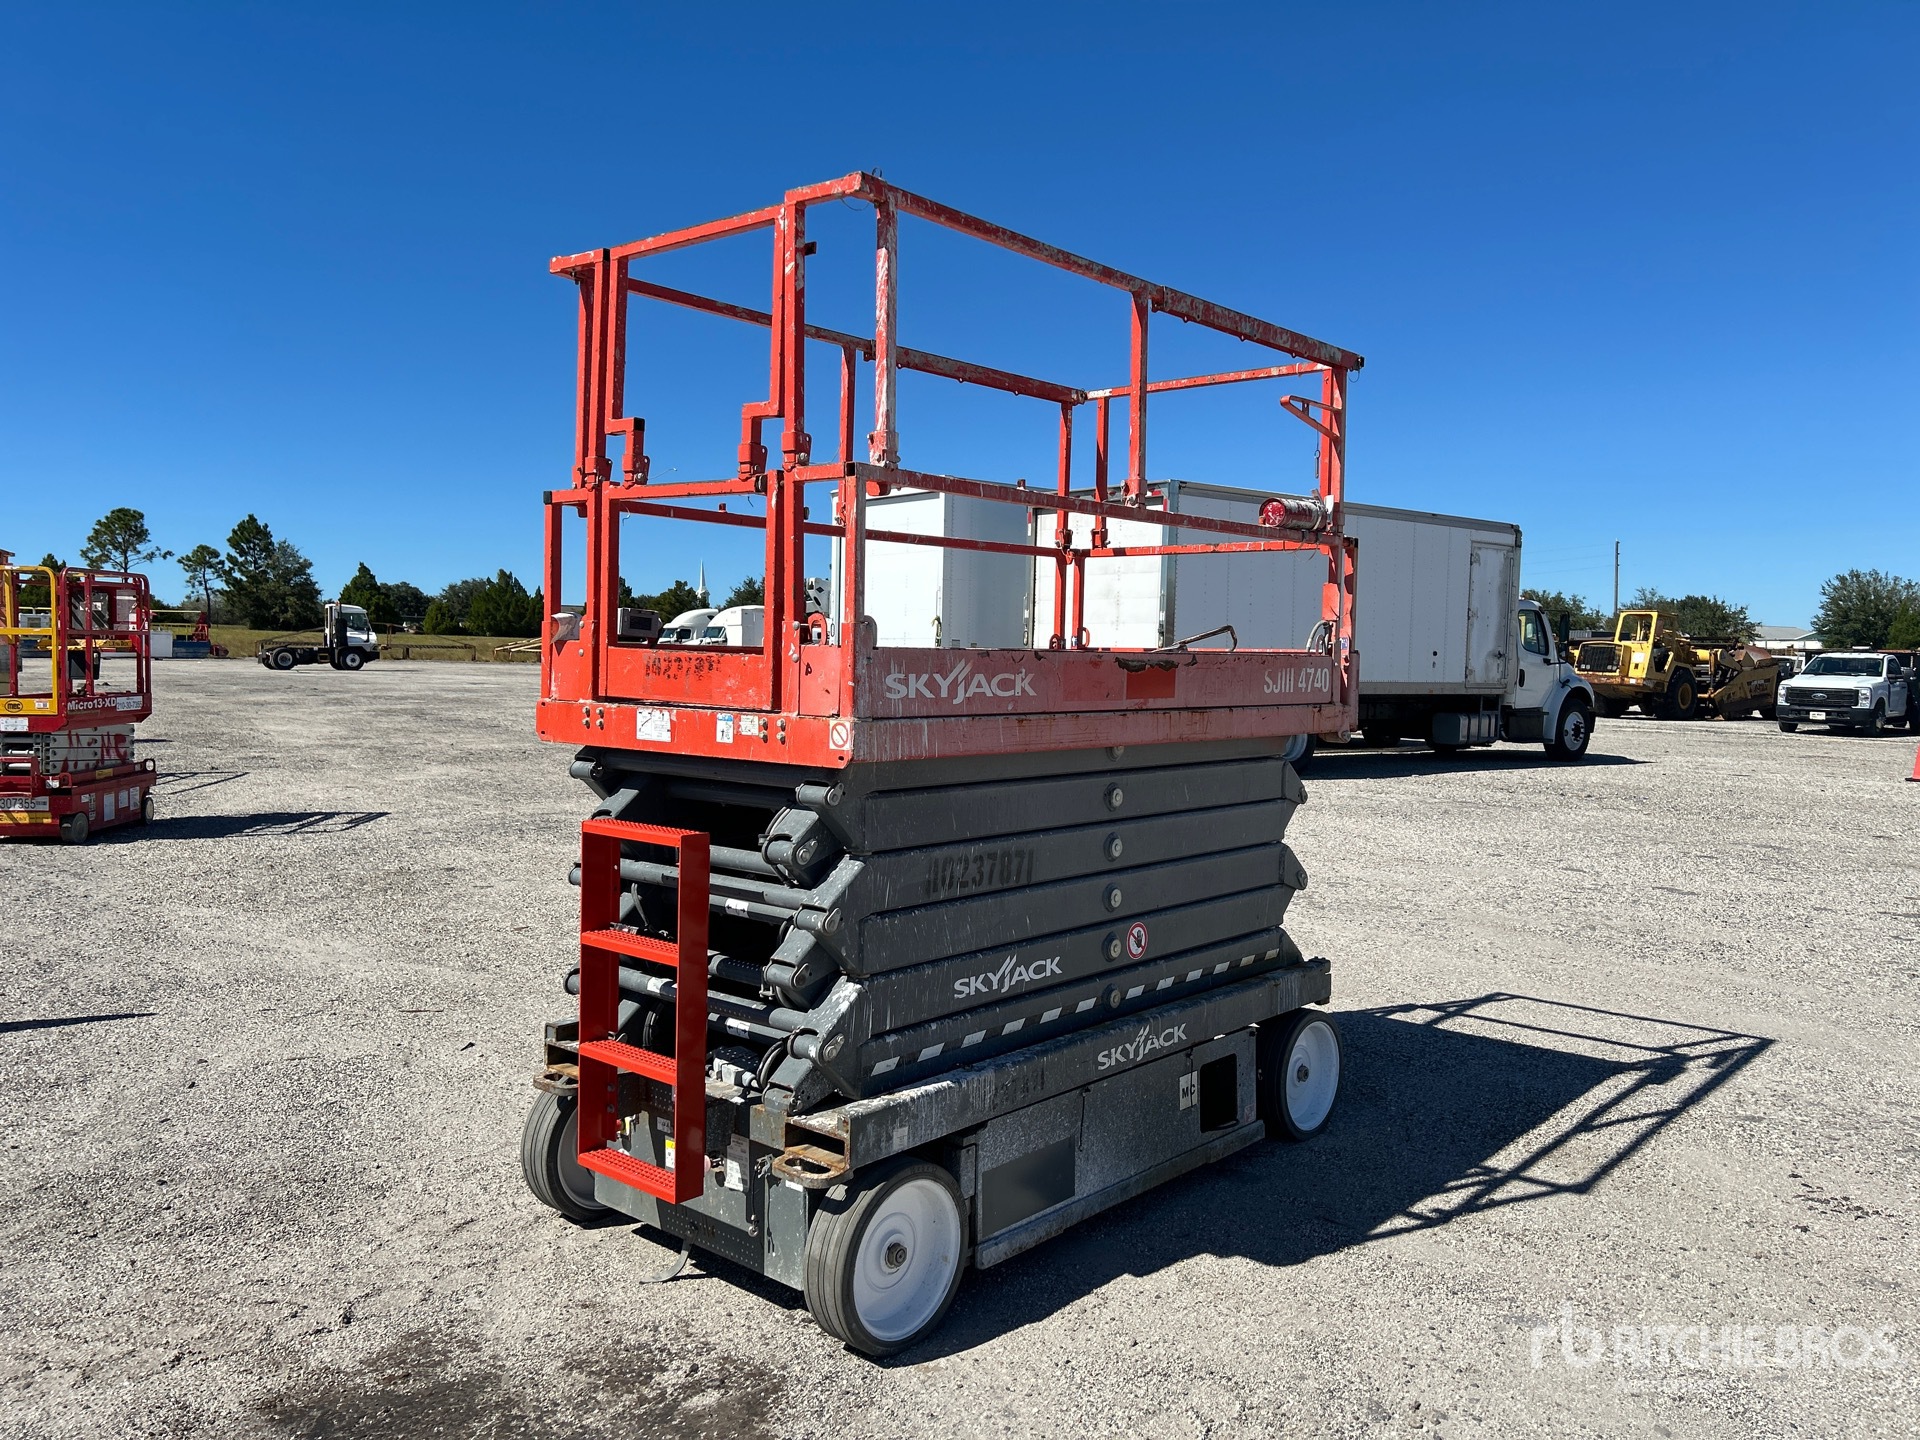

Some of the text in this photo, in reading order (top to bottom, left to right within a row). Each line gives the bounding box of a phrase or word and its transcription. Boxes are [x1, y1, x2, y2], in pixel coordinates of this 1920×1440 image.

[885, 658, 1037, 704] SKYJACK
[1298, 668, 1329, 692] 4740
[953, 954, 1063, 999] SKYJACK
[1097, 1022, 1187, 1070] SKYJACK
